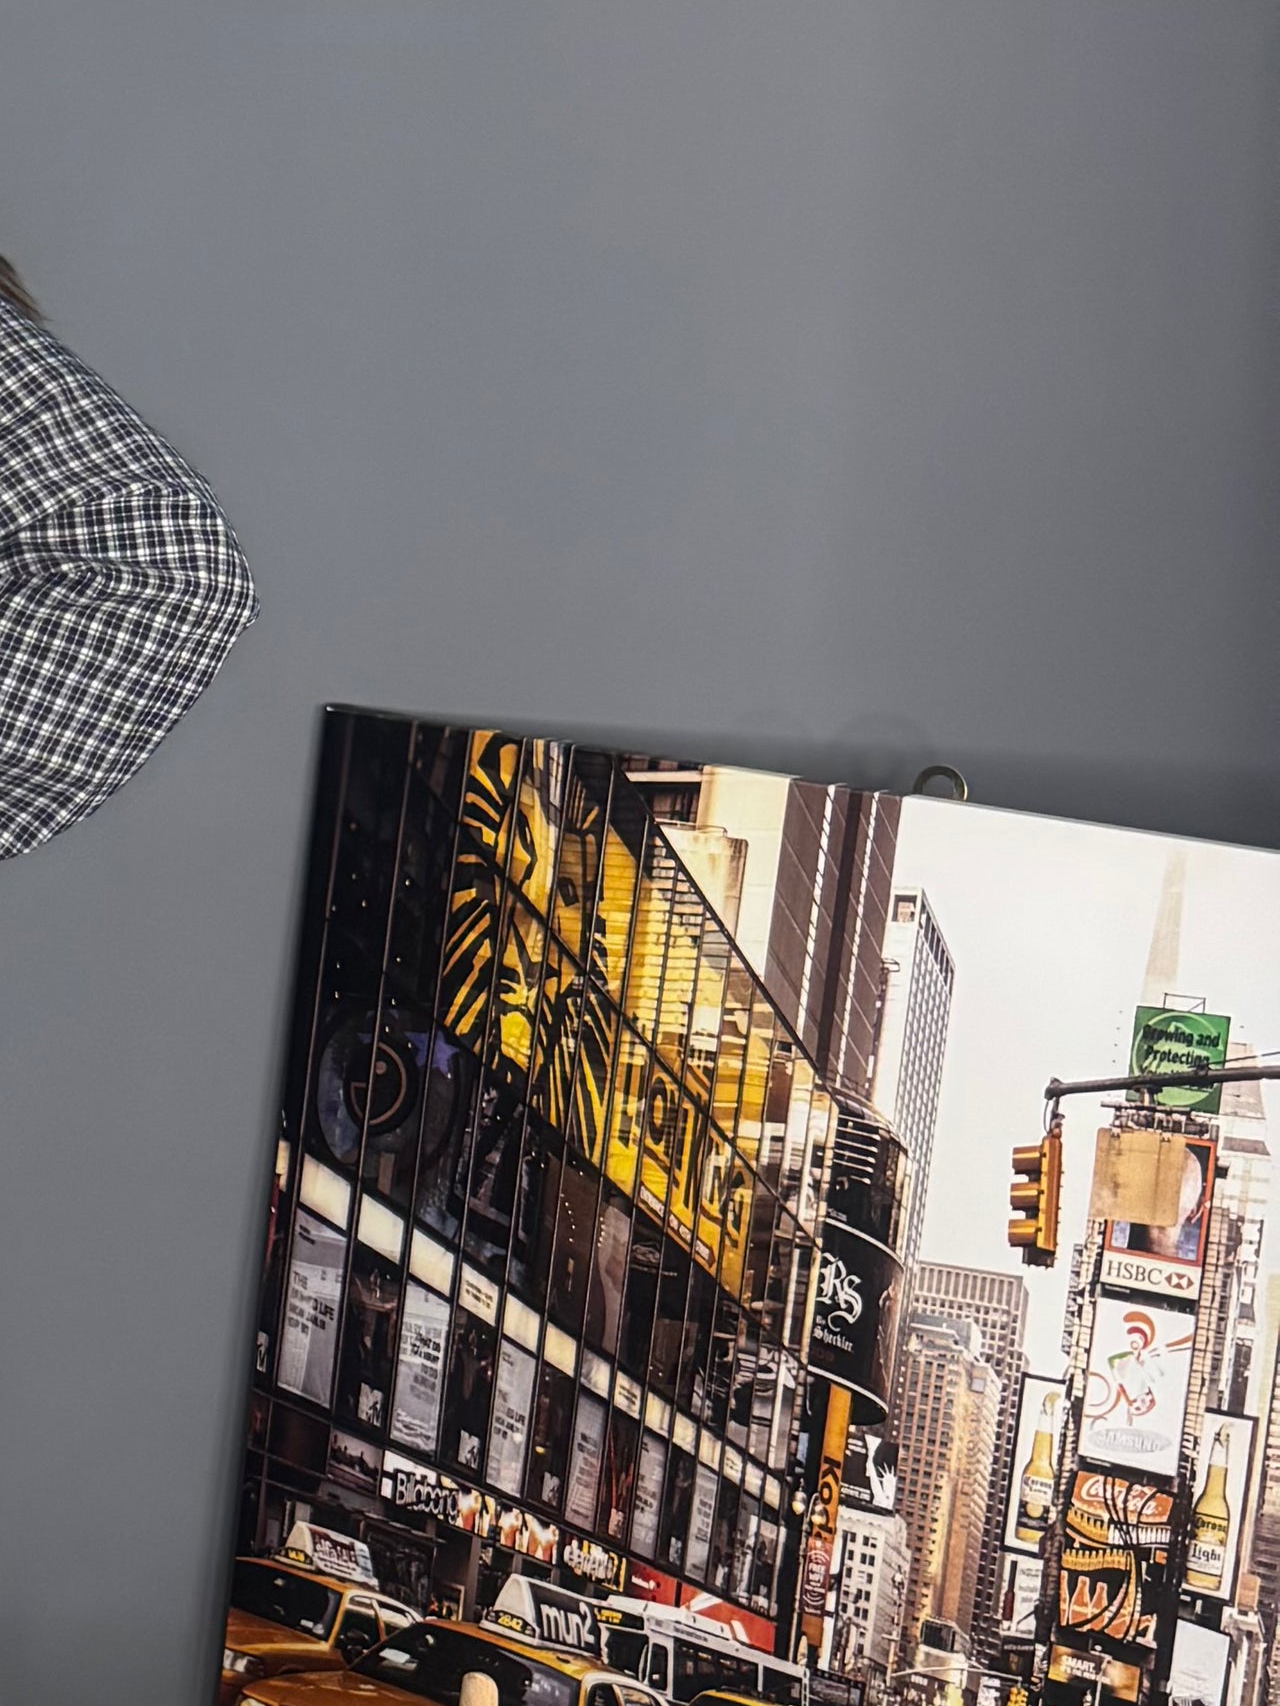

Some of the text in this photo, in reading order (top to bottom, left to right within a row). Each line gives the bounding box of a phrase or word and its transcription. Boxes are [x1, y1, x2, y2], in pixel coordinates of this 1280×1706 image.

[1196, 1031, 1221, 1048] and
[1106, 1259, 1163, 1285] HSBC
[540, 1601, 595, 1648] mun2
